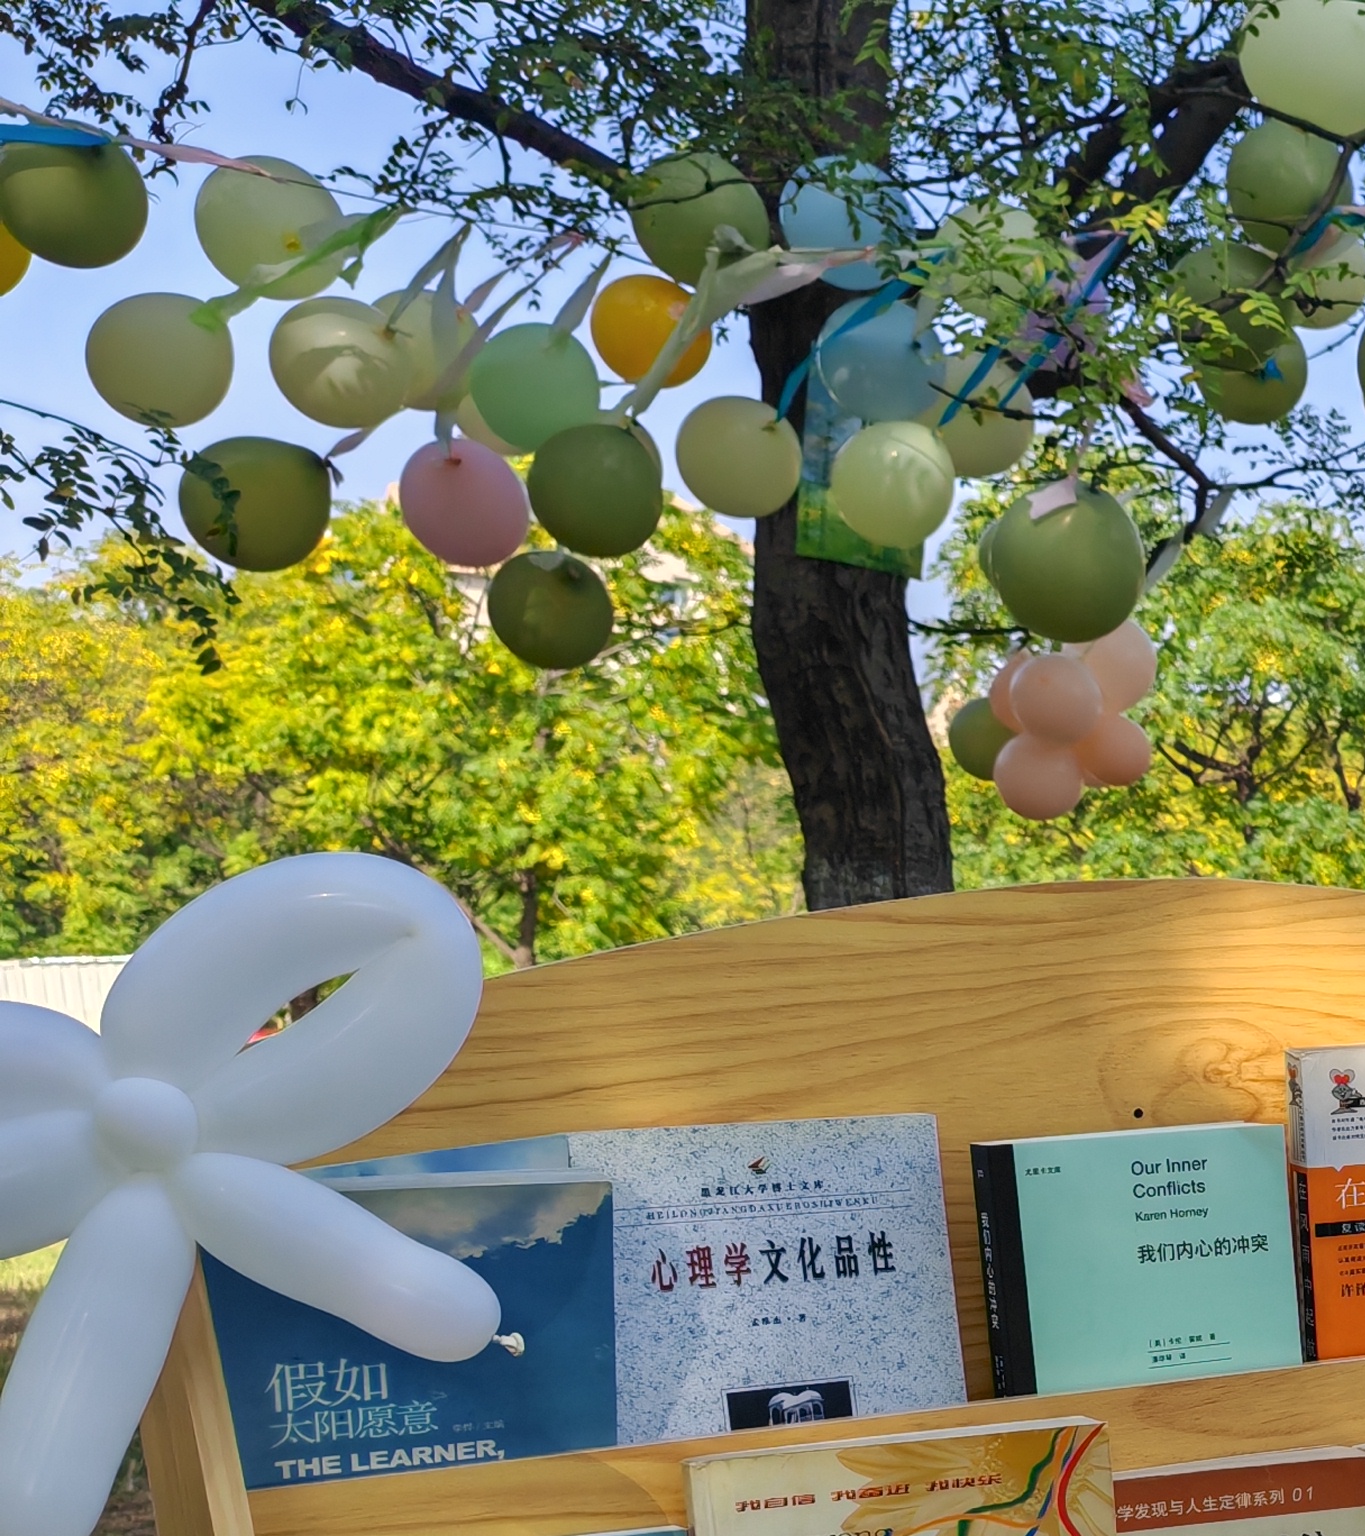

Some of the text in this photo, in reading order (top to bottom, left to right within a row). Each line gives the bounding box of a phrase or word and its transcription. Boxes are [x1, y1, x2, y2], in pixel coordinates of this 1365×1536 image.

[1131, 1156, 1208, 1176] Our Inner
[701, 1179, 826, 1198] 黑龙江大学博士文库
[1132, 1179, 1206, 1199] Conflicts
[1135, 1206, 1209, 1222] Karen Horney
[651, 1230, 896, 1292] 心理学文化品性
[1137, 1234, 1270, 1264] 我们内心的冲突
[264, 1358, 389, 1413] 假如
[269, 1399, 439, 1449] 太阳愿意
[275, 1439, 505, 1479] THE LEARNER,
[735, 1472, 1002, 1513] 我自信 我奋进 我快乐
[1115, 1487, 1314, 1522] 学发现与人生定律系列 01
